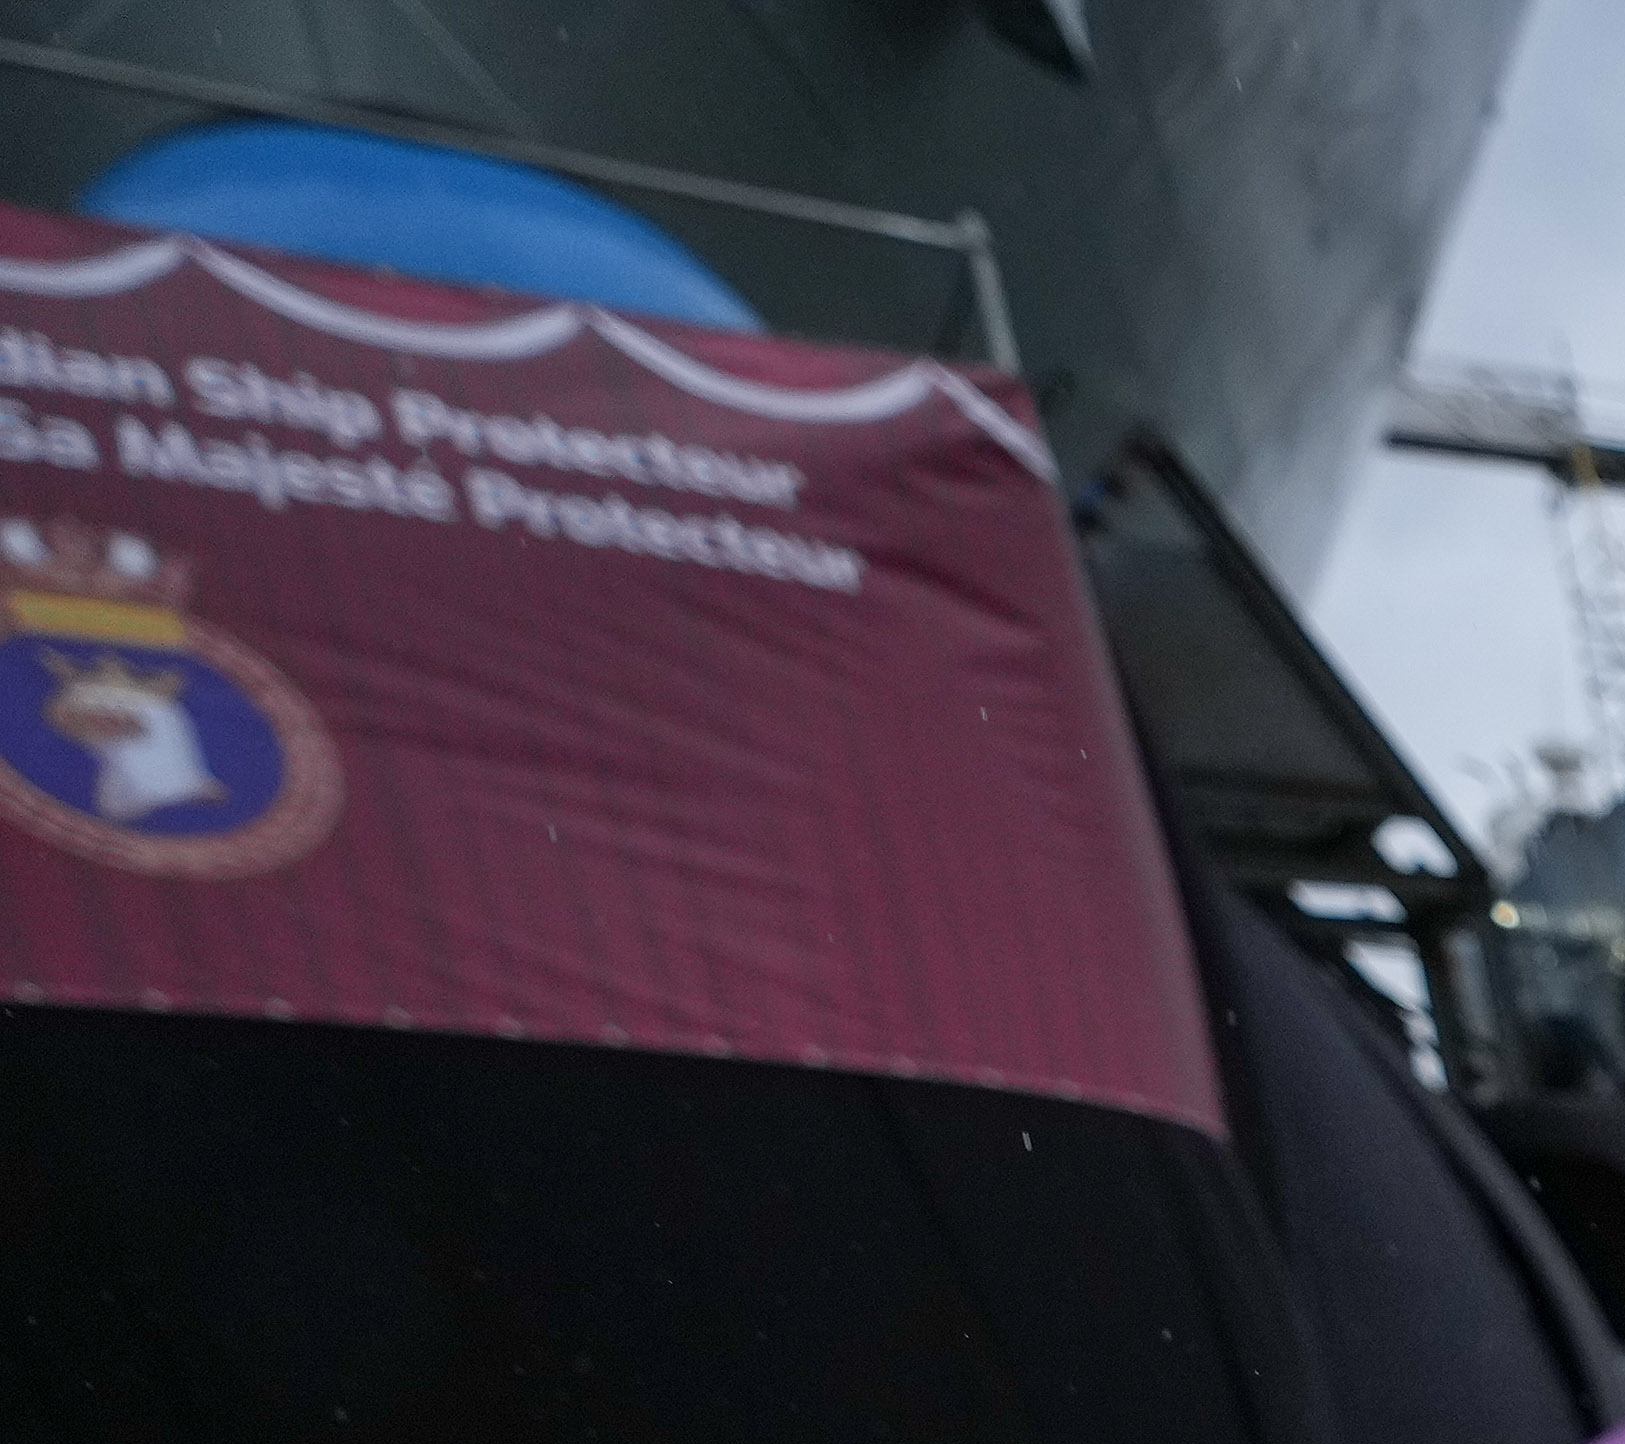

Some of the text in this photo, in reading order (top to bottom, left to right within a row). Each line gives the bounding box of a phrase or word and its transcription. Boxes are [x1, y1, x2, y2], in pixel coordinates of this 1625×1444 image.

[0, 397, 866, 596] Sa Majesté Protecteur
[185, 356, 383, 448] Ship
[392, 388, 804, 511] Protecteur
